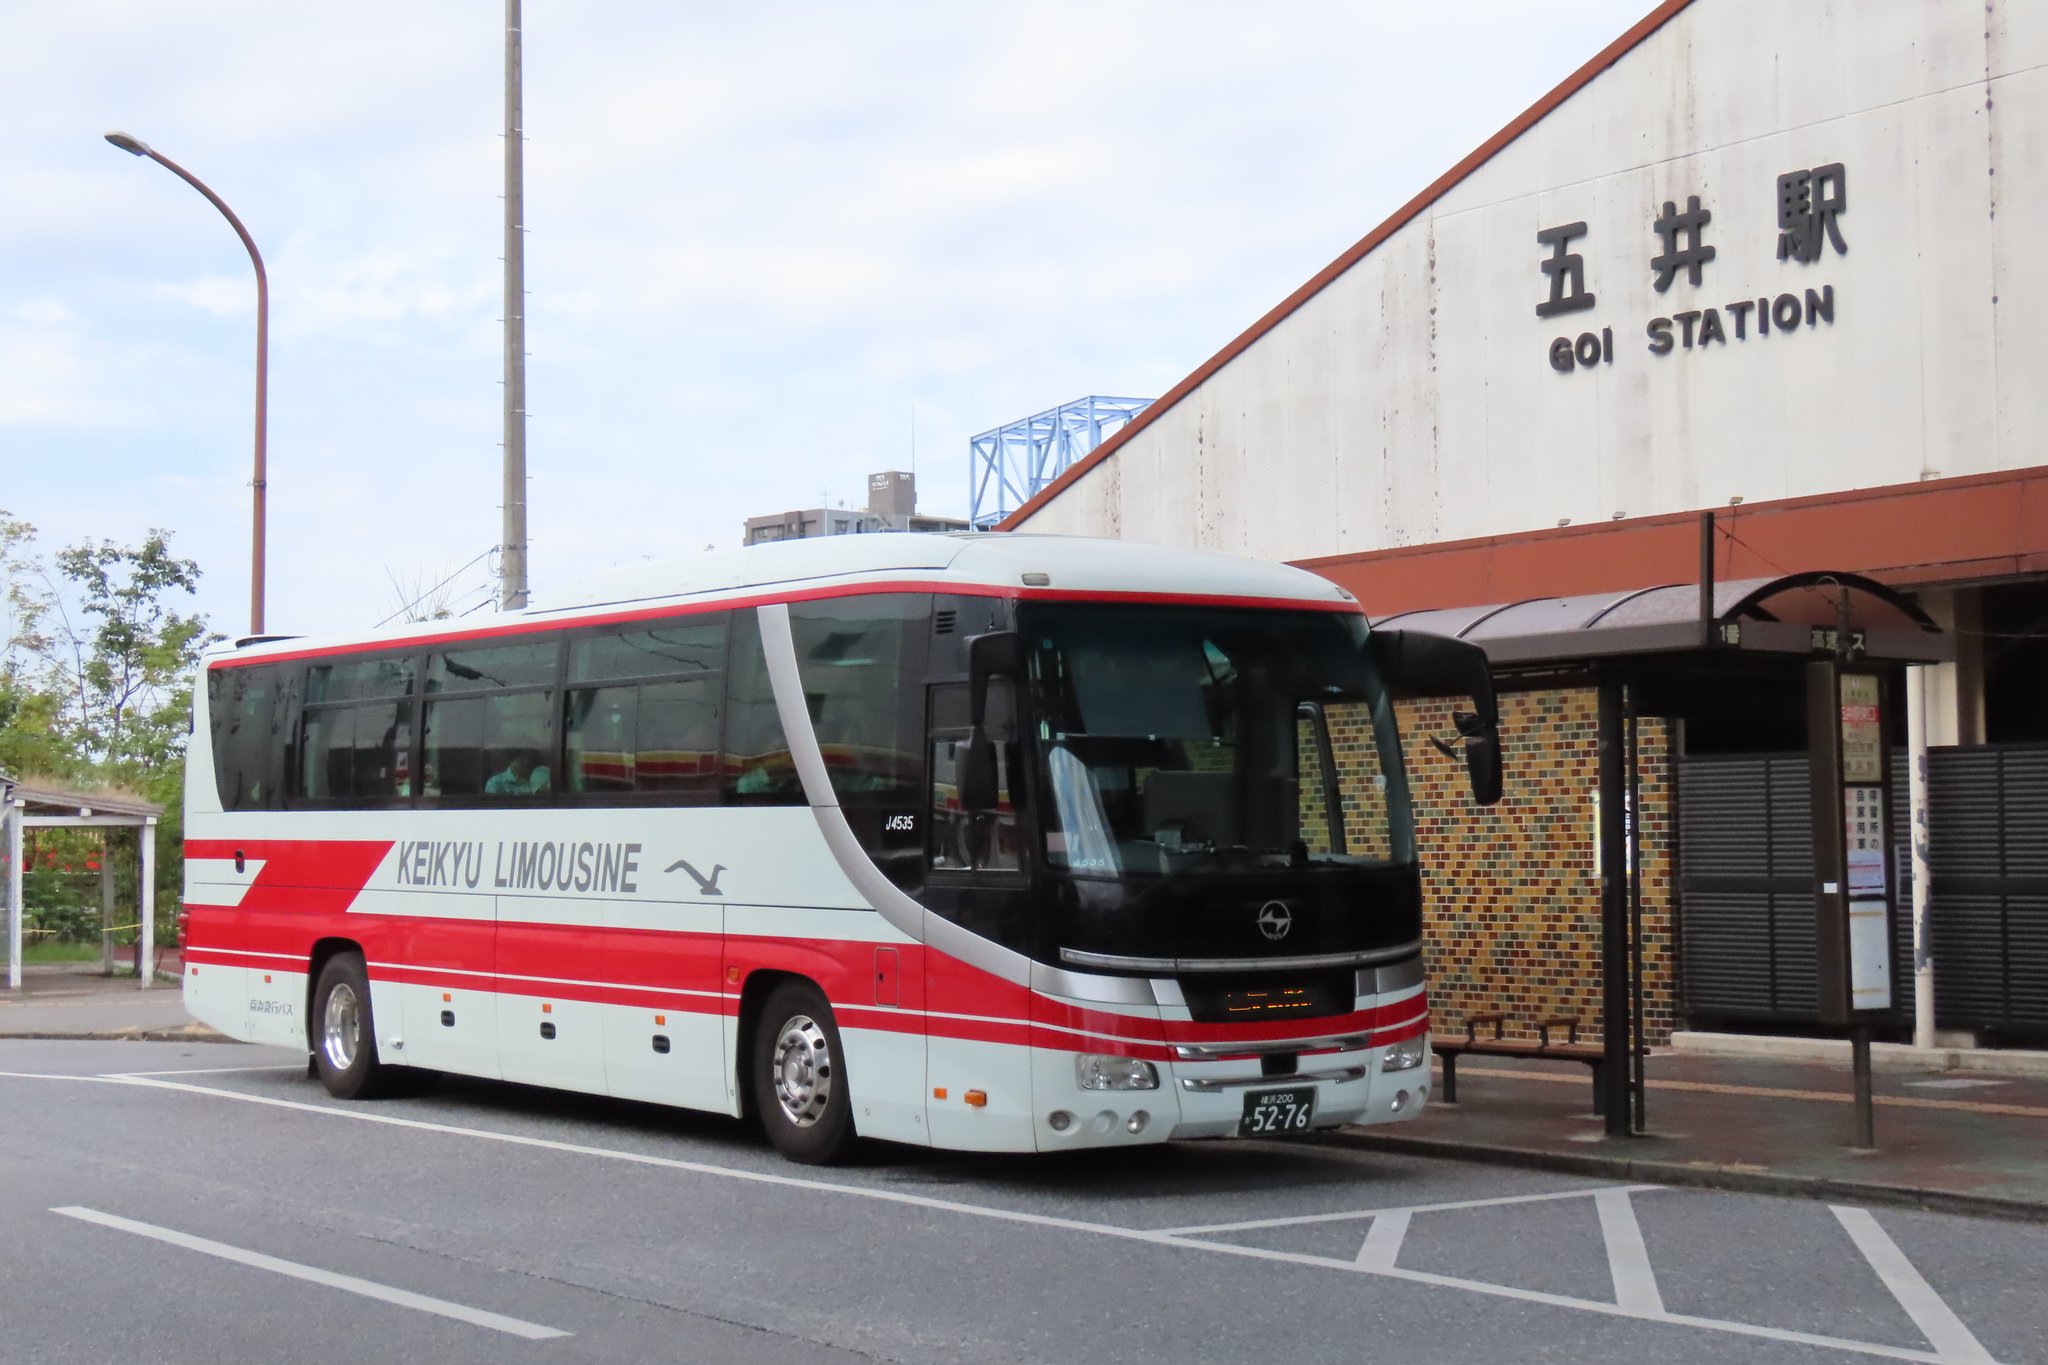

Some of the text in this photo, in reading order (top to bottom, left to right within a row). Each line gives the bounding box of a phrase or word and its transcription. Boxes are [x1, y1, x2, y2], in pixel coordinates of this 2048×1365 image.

[1536, 162, 1847, 318] 五井駅
[1549, 285, 1834, 372] GOI STATION
[1719, 624, 1740, 644] 1番
[1811, 630, 1865, 650] 高速ス
[886, 816, 914, 830] J4535
[397, 841, 642, 893] KEIKYU LIMOUSINE
[250, 999, 293, 1016] 京浜急行バス
[1252, 1103, 1309, 1132] 52-76
